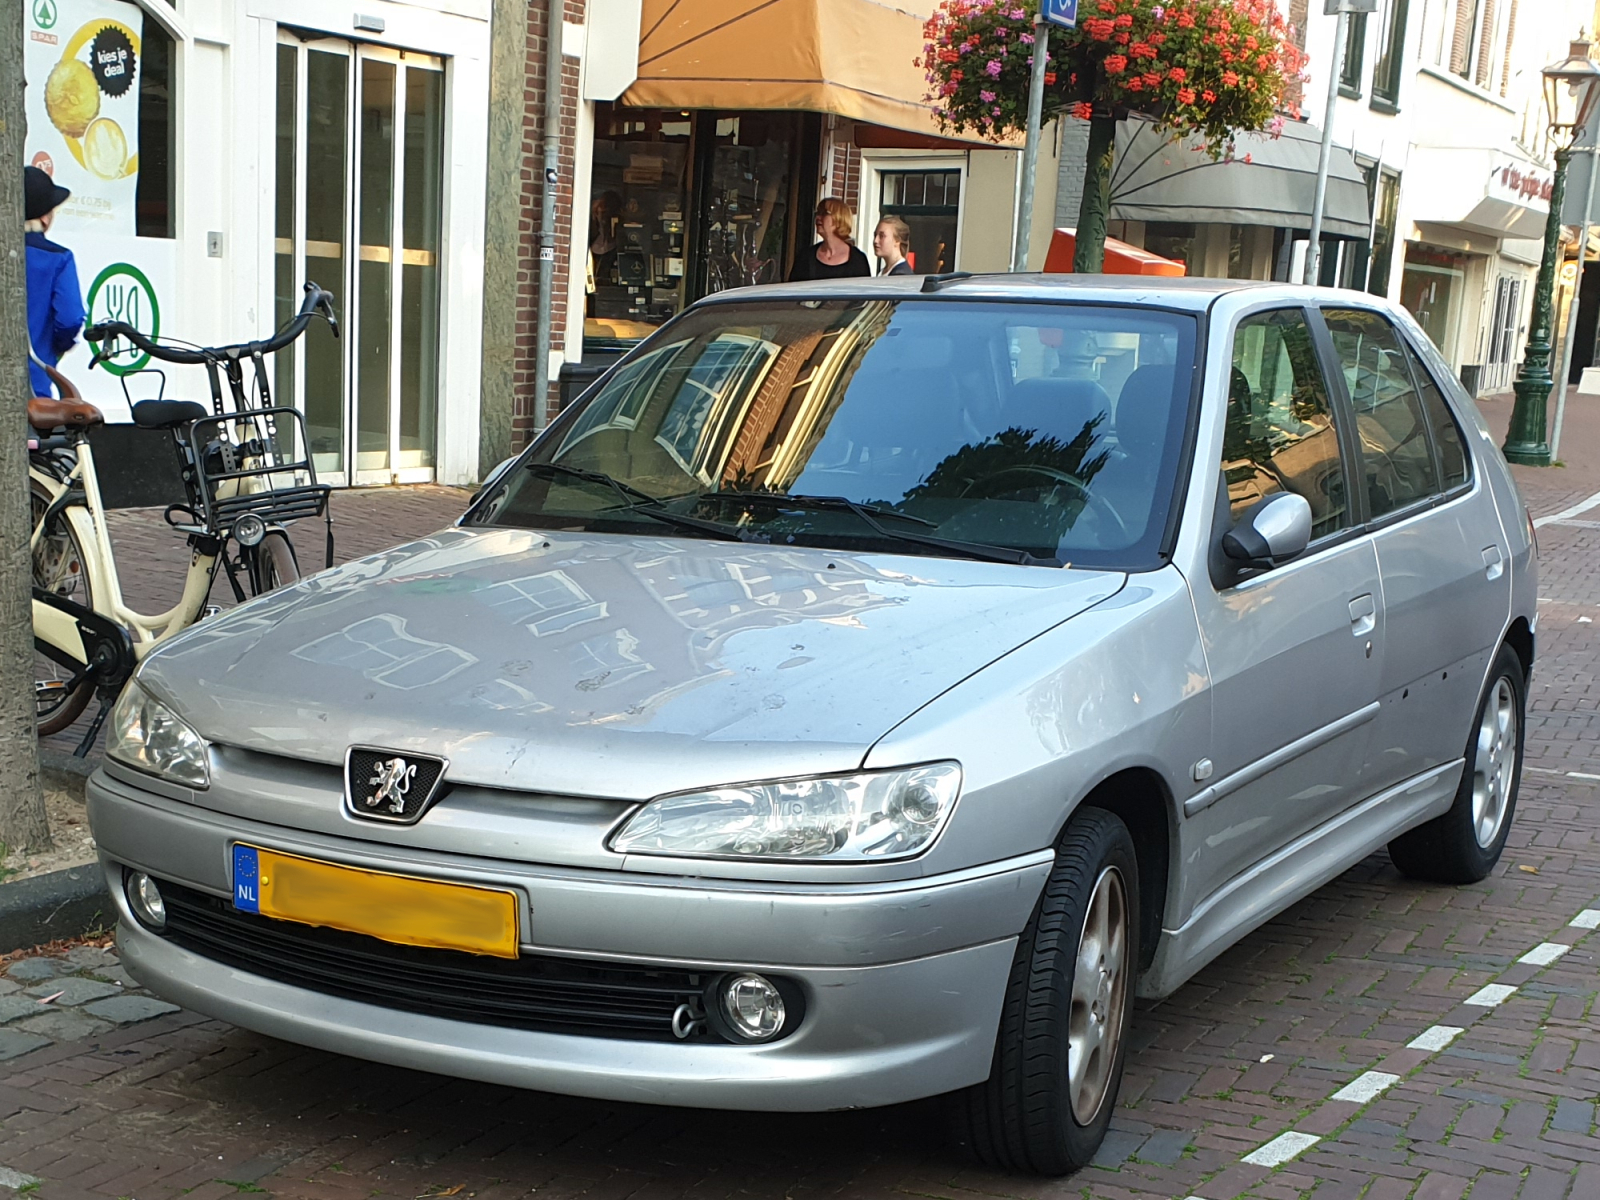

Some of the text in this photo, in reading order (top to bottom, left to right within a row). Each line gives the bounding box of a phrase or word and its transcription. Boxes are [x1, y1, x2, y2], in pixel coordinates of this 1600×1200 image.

[31, 32, 57, 44] SPAR
[97, 47, 127, 64] kies je
[104, 62, 124, 77] deal
[239, 884, 256, 901] NL
